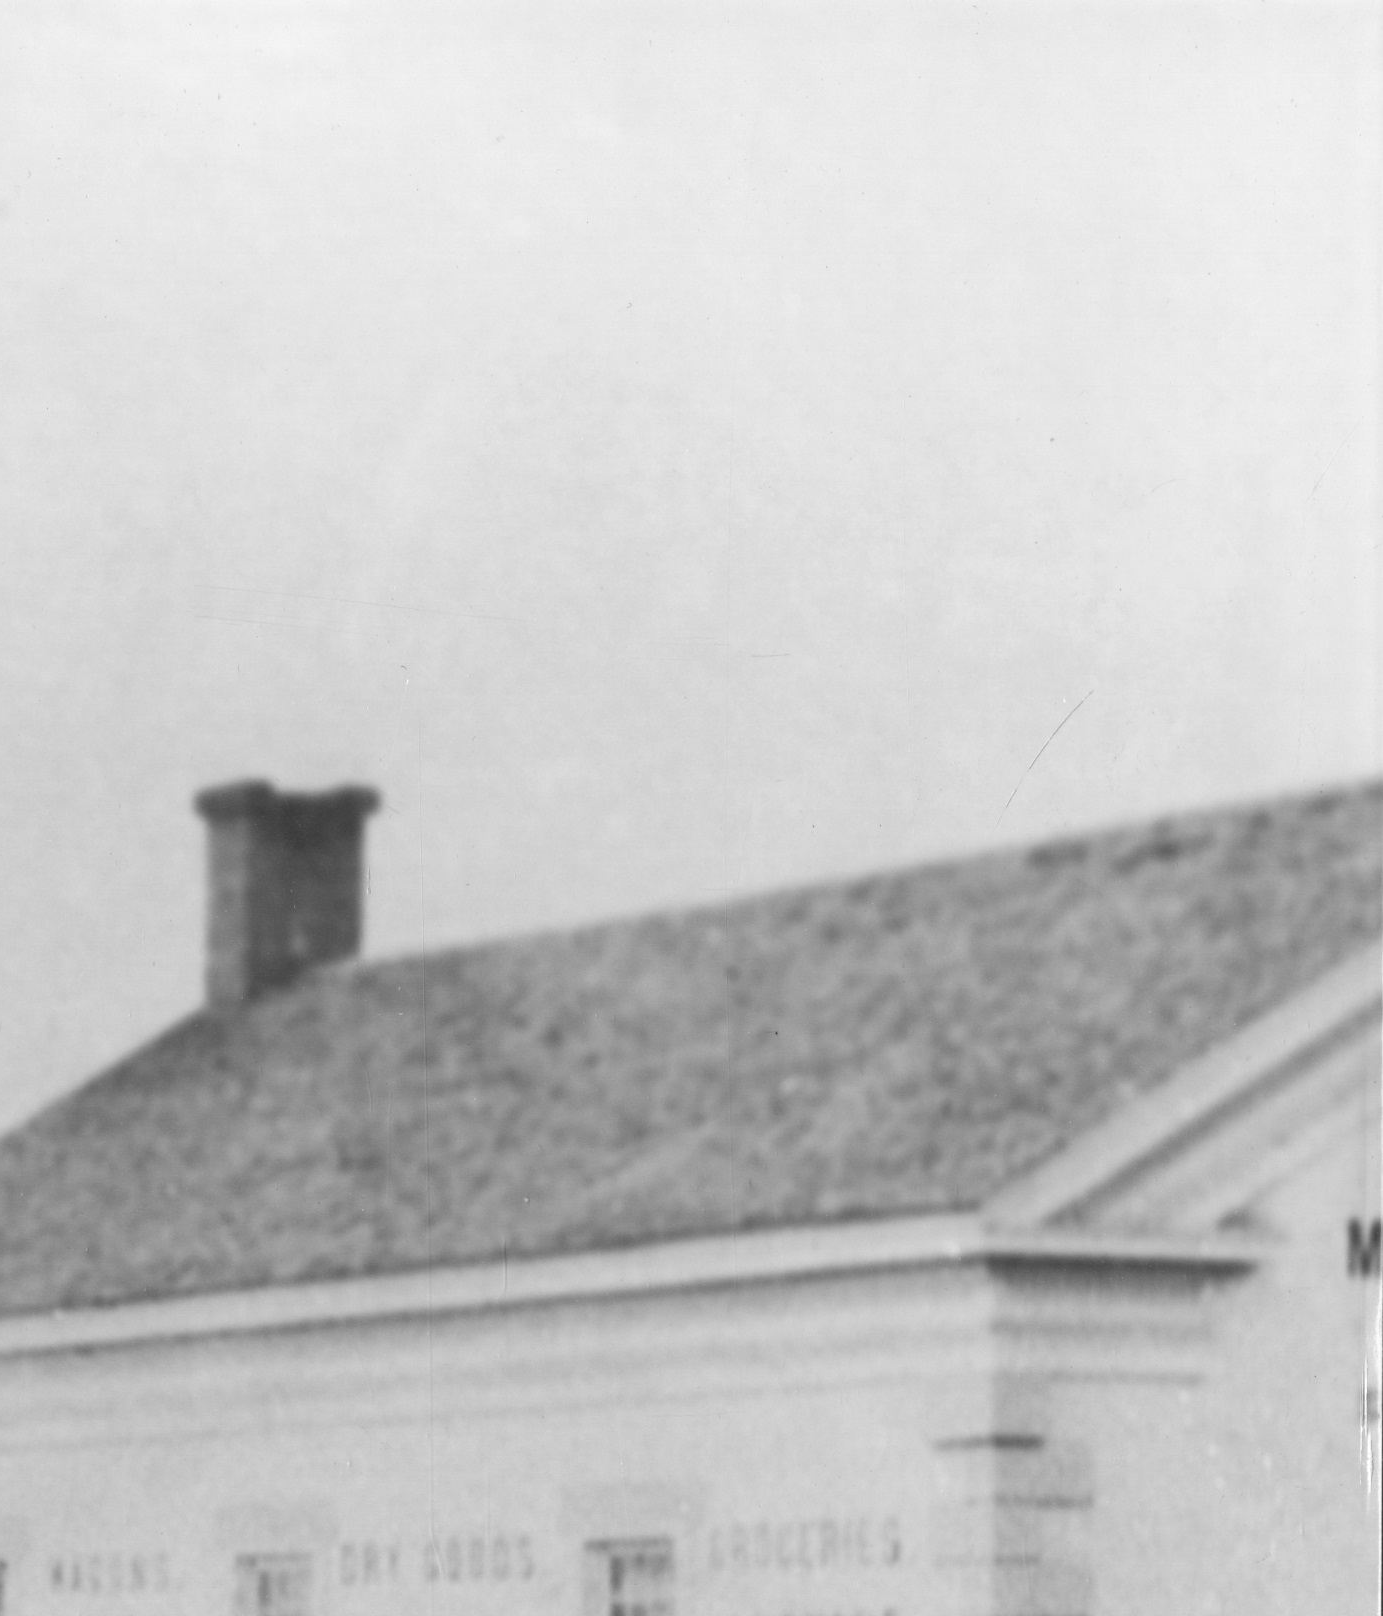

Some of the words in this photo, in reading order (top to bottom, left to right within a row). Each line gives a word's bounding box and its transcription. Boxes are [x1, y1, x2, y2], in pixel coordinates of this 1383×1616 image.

[340, 1540, 401, 1588] DRY
[423, 1533, 537, 1584] GOODS
[707, 1515, 905, 1573] GROCERIES
